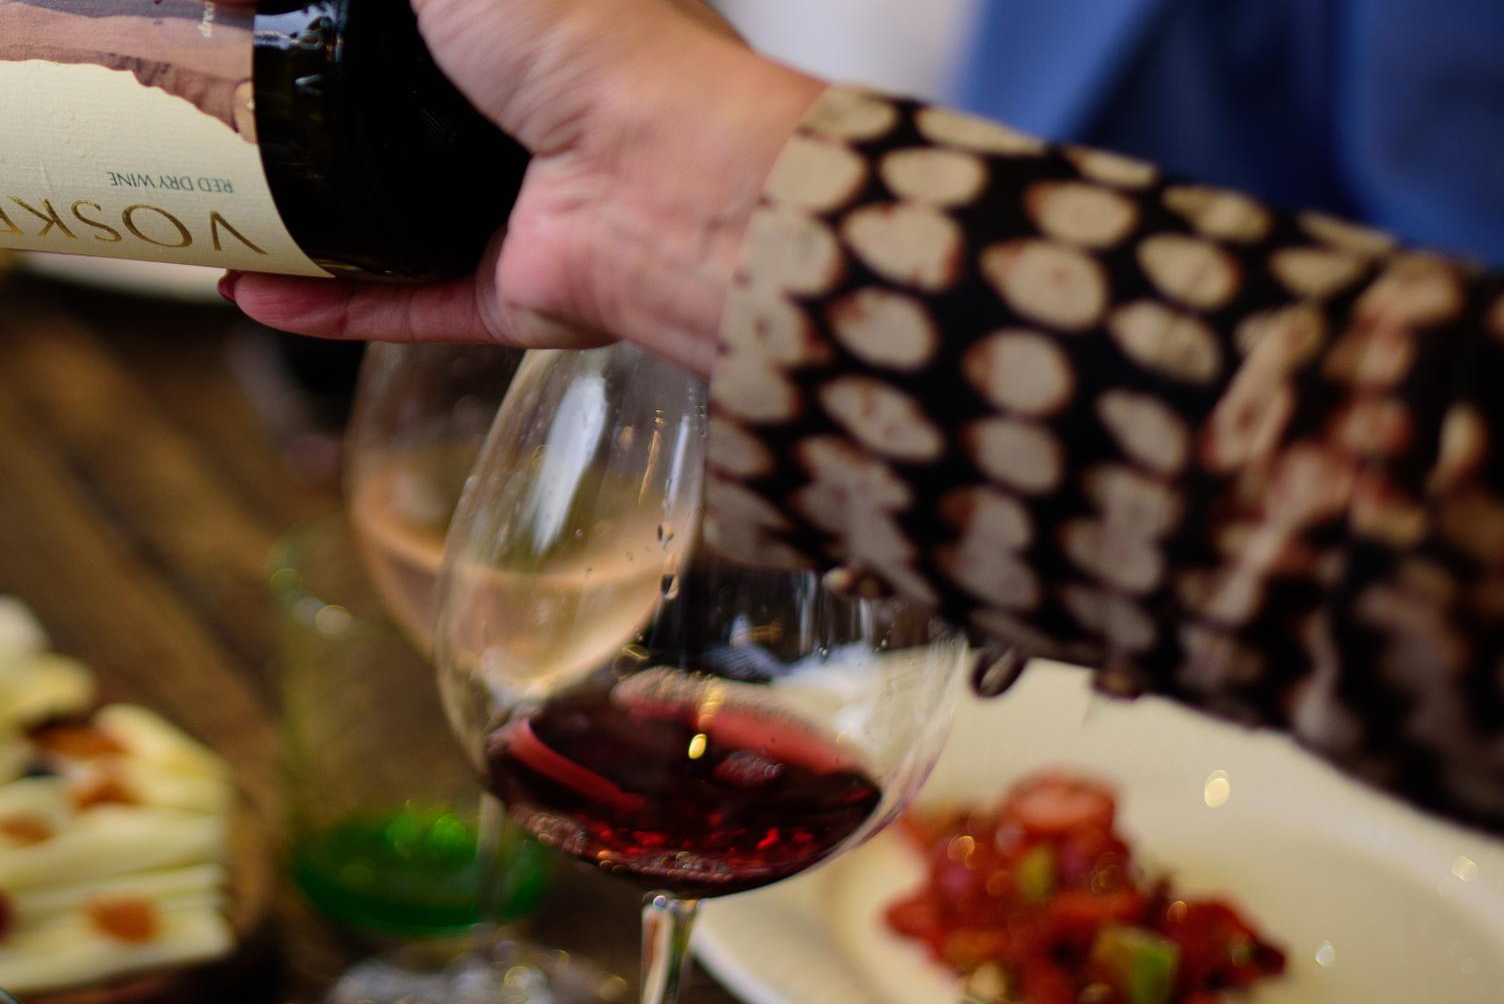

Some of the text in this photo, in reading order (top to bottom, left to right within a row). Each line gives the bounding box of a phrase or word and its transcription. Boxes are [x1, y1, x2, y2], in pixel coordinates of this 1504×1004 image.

[106, 171, 234, 194] RED DRY WINE
